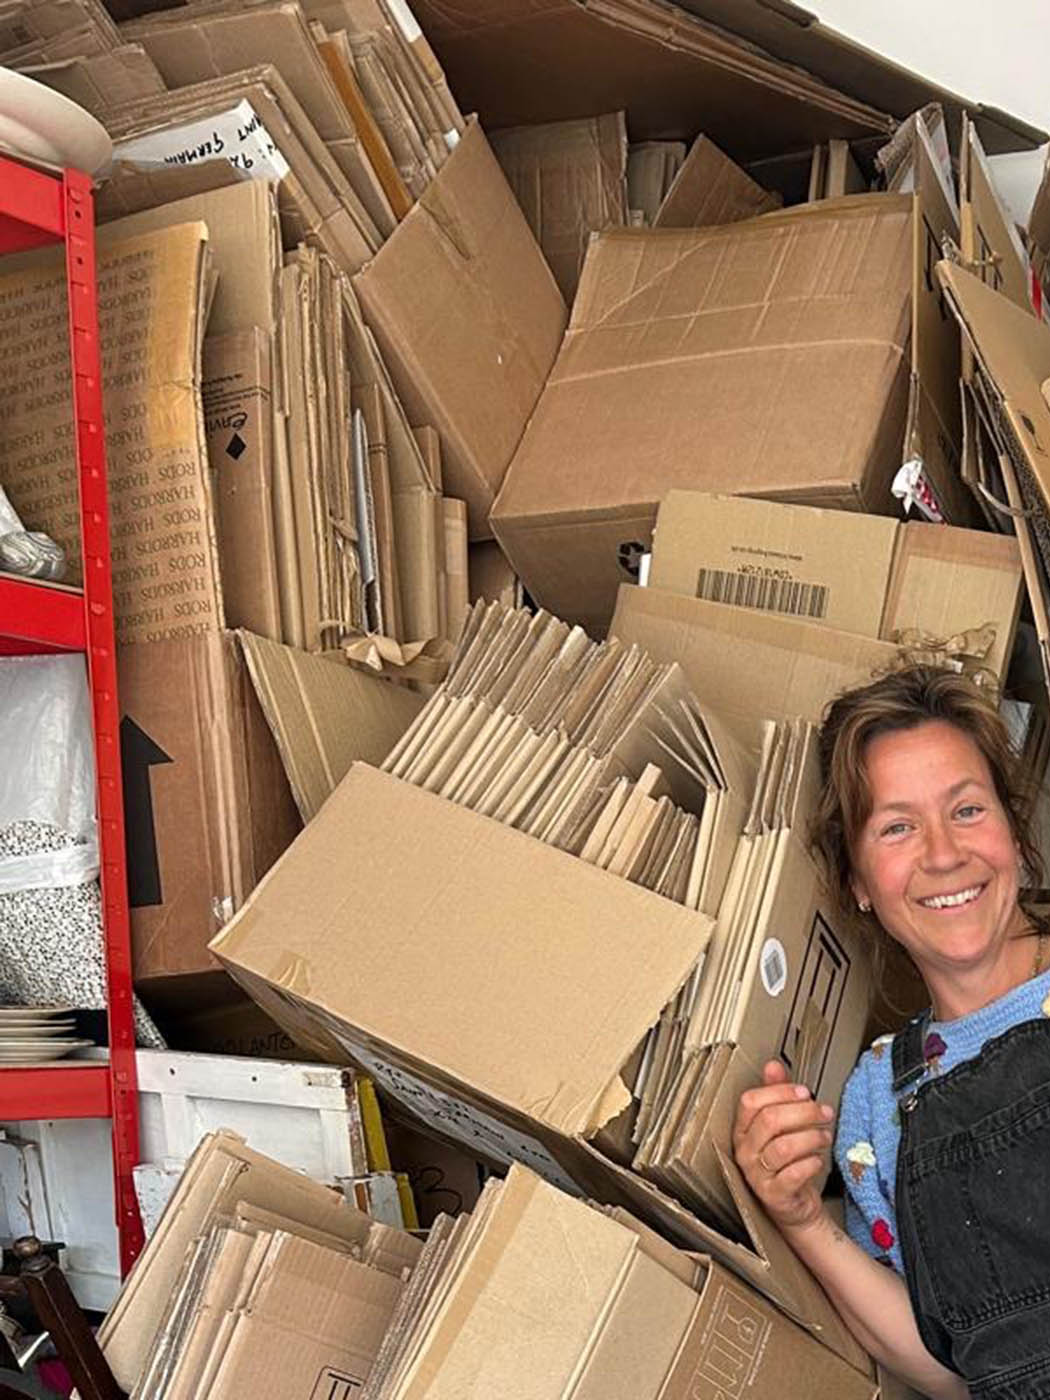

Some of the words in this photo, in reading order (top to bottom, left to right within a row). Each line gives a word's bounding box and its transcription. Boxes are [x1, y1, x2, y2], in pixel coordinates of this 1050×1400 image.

[135, 531, 201, 557] HARRODS
[168, 551, 206, 572] RODS
[140, 576, 206, 601] HARRODS
[173, 598, 212, 617] RODS
